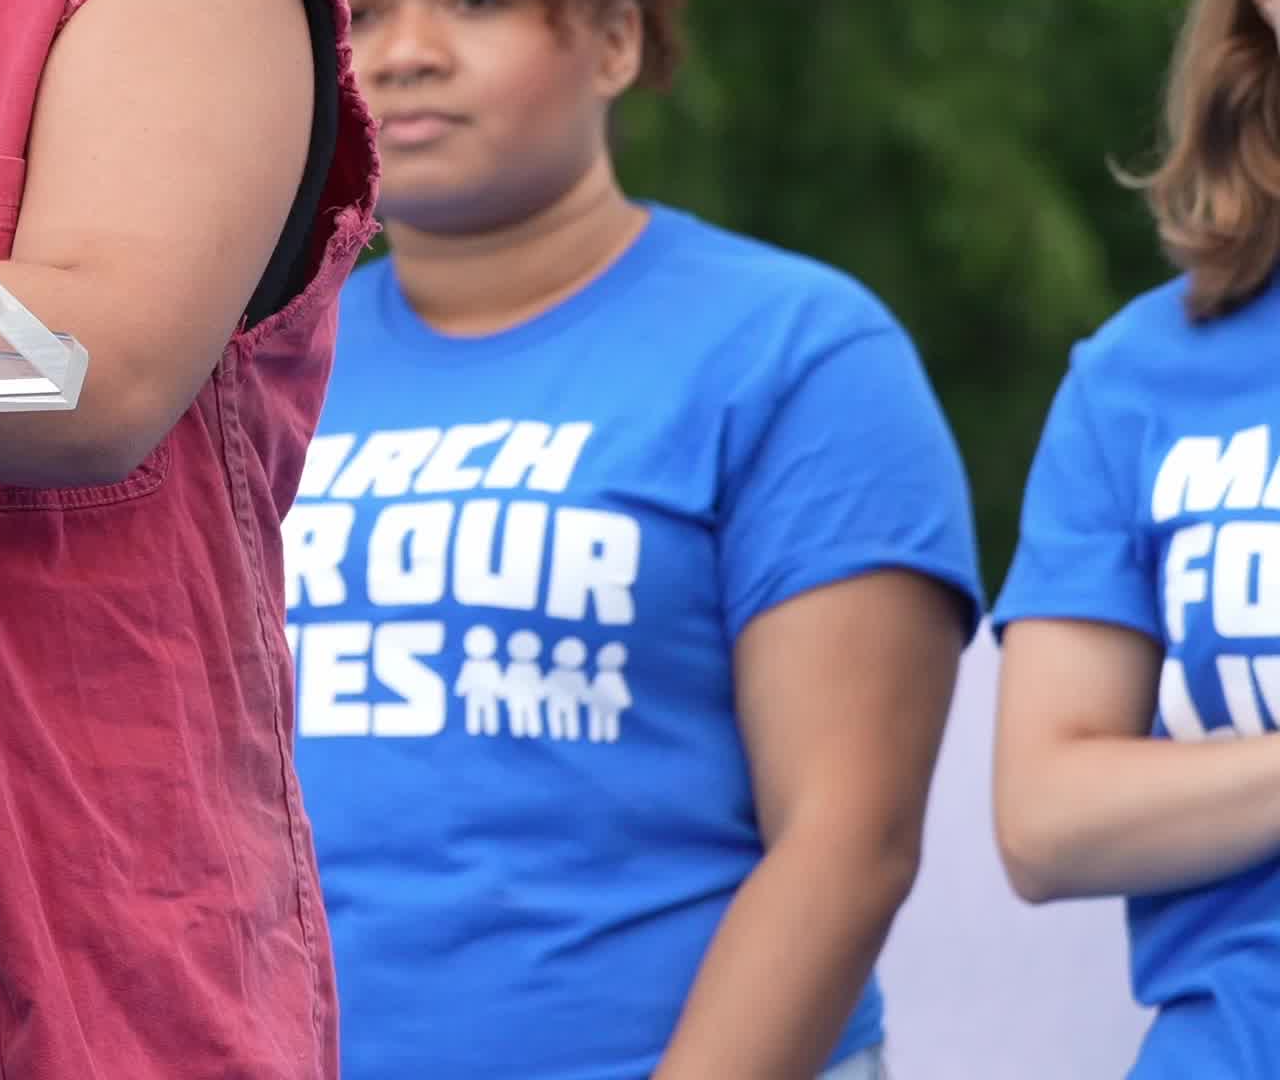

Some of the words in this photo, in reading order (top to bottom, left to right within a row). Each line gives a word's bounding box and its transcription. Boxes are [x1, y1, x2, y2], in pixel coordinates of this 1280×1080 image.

[297, 420, 593, 498] RCH
[366, 498, 640, 625] OUR
[1163, 521, 1280, 644] FO
